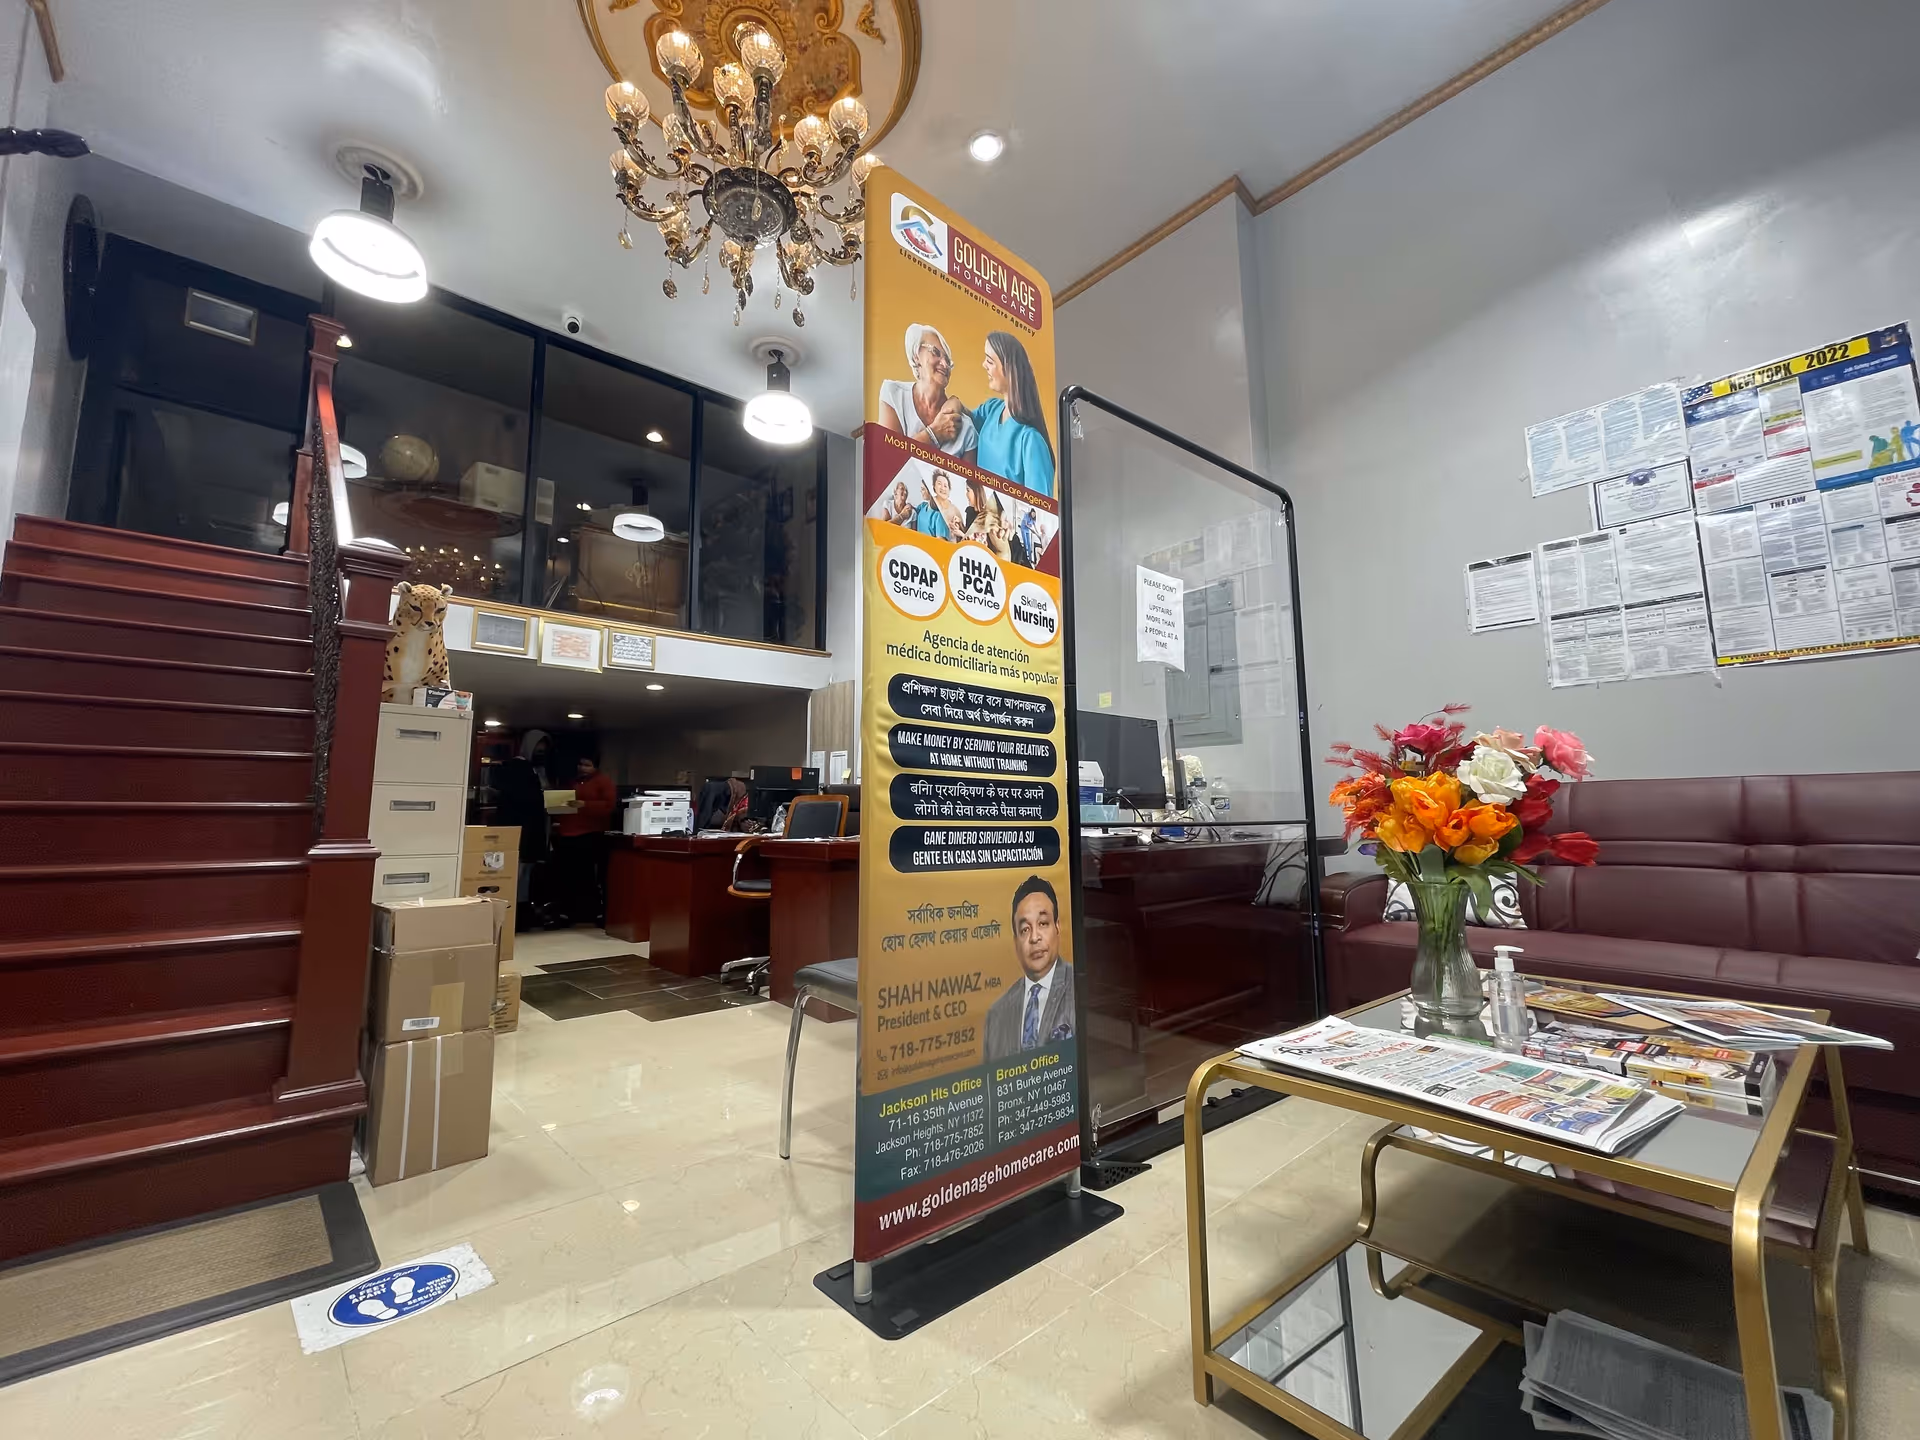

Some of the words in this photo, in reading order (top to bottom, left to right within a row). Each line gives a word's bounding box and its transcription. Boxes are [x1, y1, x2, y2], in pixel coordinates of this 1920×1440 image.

[954, 236, 1008, 293] GOLDEN
[1010, 276, 1036, 312] AGE
[900, 249, 938, 276] Licensed
[940, 273, 962, 291] Home
[964, 287, 989, 308] Health
[991, 304, 1008, 319] Care
[1010, 316, 1036, 337] Agency
[954, 262, 992, 294] HOME
[1001, 294, 1035, 322] CARE
[1804, 343, 1851, 370] 2022
[1729, 372, 1756, 393] NEW
[1760, 361, 1792, 386] YORK
[884, 434, 908, 450] Most
[910, 443, 945, 466] Popular
[947, 459, 973, 477] Home
[975, 468, 1001, 489] Health
[1003, 482, 1021, 498] Care
[1023, 492, 1052, 510] Agency
[1770, 500, 1785, 509] THE
[1787, 495, 1806, 507] LAW
[888, 558, 938, 588] CDPAP
[959, 556, 997, 581] HHA/
[893, 580, 935, 602] Service
[962, 572, 995, 597] PCA
[1144, 578, 1161, 590] PLEASE
[957, 589, 1000, 610] Service
[1020, 595, 1047, 612] Skilled
[1149, 604, 1173, 616] UPSTAIRS
[1013, 604, 1055, 633] Nursing
[1146, 614, 1161, 624] MORE
[1162, 618, 1176, 628] THAN
[923, 629, 968, 650] Agencia
[971, 640, 985, 654] de
[987, 644, 1030, 664] atención
[1149, 627, 1166, 639] PEOPLE
[1155, 640, 1168, 649] TIME
[886, 643, 931, 663] médica
[934, 650, 998, 675] domiciliaria
[1000, 665, 1020, 679] más
[1023, 670, 1059, 686] popular
[901, 679, 937, 698] প্রশিক্ষণ
[939, 686, 966, 703] ছাড়াই
[967, 691, 983, 705] ঘরে
[986, 694, 1002, 708] বসে
[1003, 697, 1047, 714] আপনজনকে
[920, 703, 941, 718] সেবা
[943, 703, 963, 720] দিয়ে
[965, 708, 981, 722] অর্থ
[982, 708, 1012, 726] উপার্জন
[1012, 715, 1034, 728] করুন
[897, 730, 922, 746] MAKE
[923, 732, 951, 749] MONEY
[952, 734, 964, 750] BY
[964, 737, 995, 753] SERVING
[996, 740, 1014, 754] YOUR
[1015, 742, 1050, 757] RELATIVES
[929, 752, 940, 765] AT
[940, 753, 963, 767] HOME
[964, 755, 996, 770] WITHOUT
[996, 757, 1028, 772] TRAINING
[986, 783, 995, 798] के
[997, 786, 1009, 799] घर
[1010, 787, 1022, 799] पर
[1023, 785, 1044, 799] अपने
[940, 800, 953, 816] की
[955, 800, 974, 817] सेवा
[975, 801, 999, 817] करके
[1000, 801, 1017, 817] पैसा
[923, 831, 947, 846] GANE
[948, 831, 978, 845] DINERO
[978, 830, 1017, 844] SIRVIENDO
[1018, 830, 1024, 844] A
[1025, 830, 1035, 844] SU
[913, 850, 942, 866] GENTE
[942, 850, 954, 865] EN
[955, 849, 977, 864] CASA
[978, 848, 991, 863] SIN
[992, 846, 1044, 863] CAPACITACIÓN
[906, 902, 944, 924] সর্বাধিক
[881, 934, 905, 952] হোম
[909, 930, 936, 949] হেলথ
[877, 979, 923, 1010] SHAH
[927, 972, 982, 1001] NAWAZ
[984, 976, 1002, 991] MBA
[877, 1006, 931, 1032] President
[933, 1005, 941, 1019] &
[943, 1000, 967, 1017] CEO
[890, 1027, 976, 1061] 718-775-7852
[996, 1064, 1028, 1081] Bronx
[1030, 1053, 1060, 1070] Office
[996, 1085, 1014, 1097] 831
[1016, 1075, 1041, 1090] Burke
[1043, 1063, 1073, 1081] Avenue
[878, 1091, 928, 1118] Jackson
[930, 1086, 949, 1101] Hts
[951, 1077, 982, 1095] Office
[997, 1097, 1026, 1112] Bronx,
[1027, 1091, 1040, 1102] NY
[1043, 1079, 1067, 1096] 10467
[888, 1112, 920, 1132] 71-16
[922, 1107, 946, 1121] 35th
[947, 1094, 984, 1113] Avenue
[997, 1113, 1013, 1128] Ph:
[1014, 1092, 1071, 1122] 347-449-5983
[998, 1128, 1018, 1143] Fax:
[1019, 1104, 1075, 1135] 347-275-9834
[875, 1133, 911, 1154] Jackson
[913, 1124, 946, 1144] Heights,
[947, 1116, 960, 1129] NY
[962, 1108, 985, 1125] 11372
[905, 1146, 921, 1161] Ph:
[923, 1124, 984, 1155] 718-775-7852
[900, 1165, 922, 1180] Fax:
[923, 1139, 985, 1171] 718-476-2026
[878, 1133, 1080, 1231] www.goldenagehomecare.com
[359, 1283, 386, 1296] FEET
[416, 1278, 452, 1293] WAITING
[426, 1274, 452, 1286] WHILE
[429, 1284, 447, 1293] FOR
[351, 1288, 387, 1304] APART
[407, 1290, 443, 1306] SERVICE
